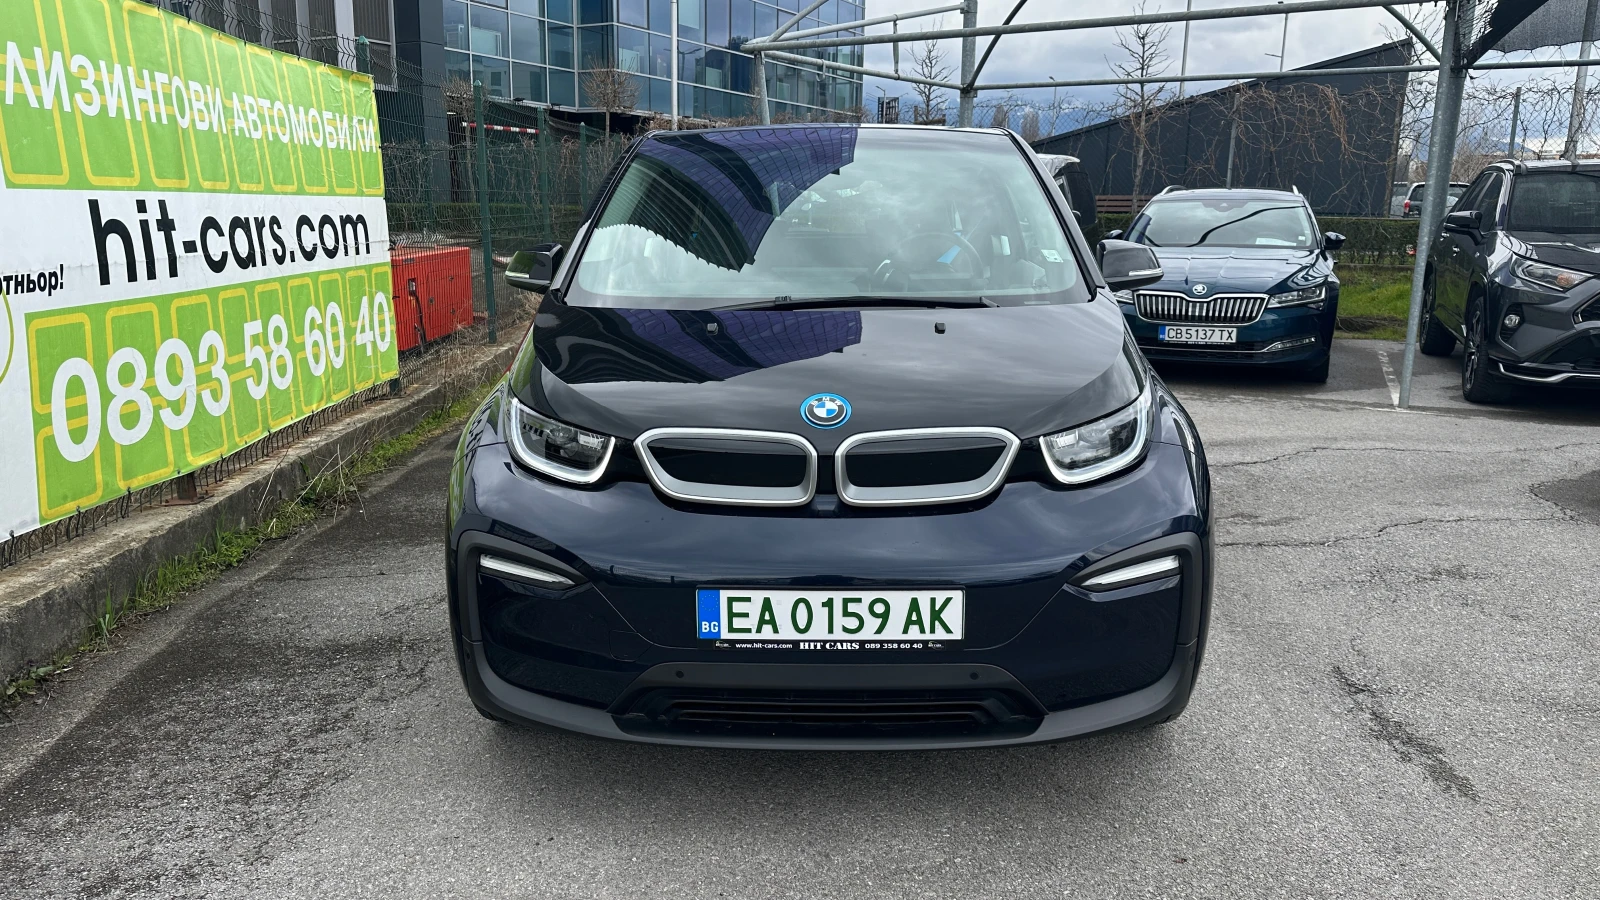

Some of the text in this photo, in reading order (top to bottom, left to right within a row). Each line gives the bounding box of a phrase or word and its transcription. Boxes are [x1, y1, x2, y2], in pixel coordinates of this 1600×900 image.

[6, 41, 377, 153] ЛИЗИНГОВИ АВТОМОБИЛИ
[88, 199, 371, 286] hit-cars.com
[0, 263, 64, 297] тньор!
[1167, 328, 1235, 341] CB 5137 TX
[51, 291, 391, 462] 0893 58 60 40
[810, 396, 843, 406] BMW
[701, 621, 719, 633] BG
[727, 597, 954, 635] EA 0159 AK
[799, 641, 860, 650] HIT CARS
